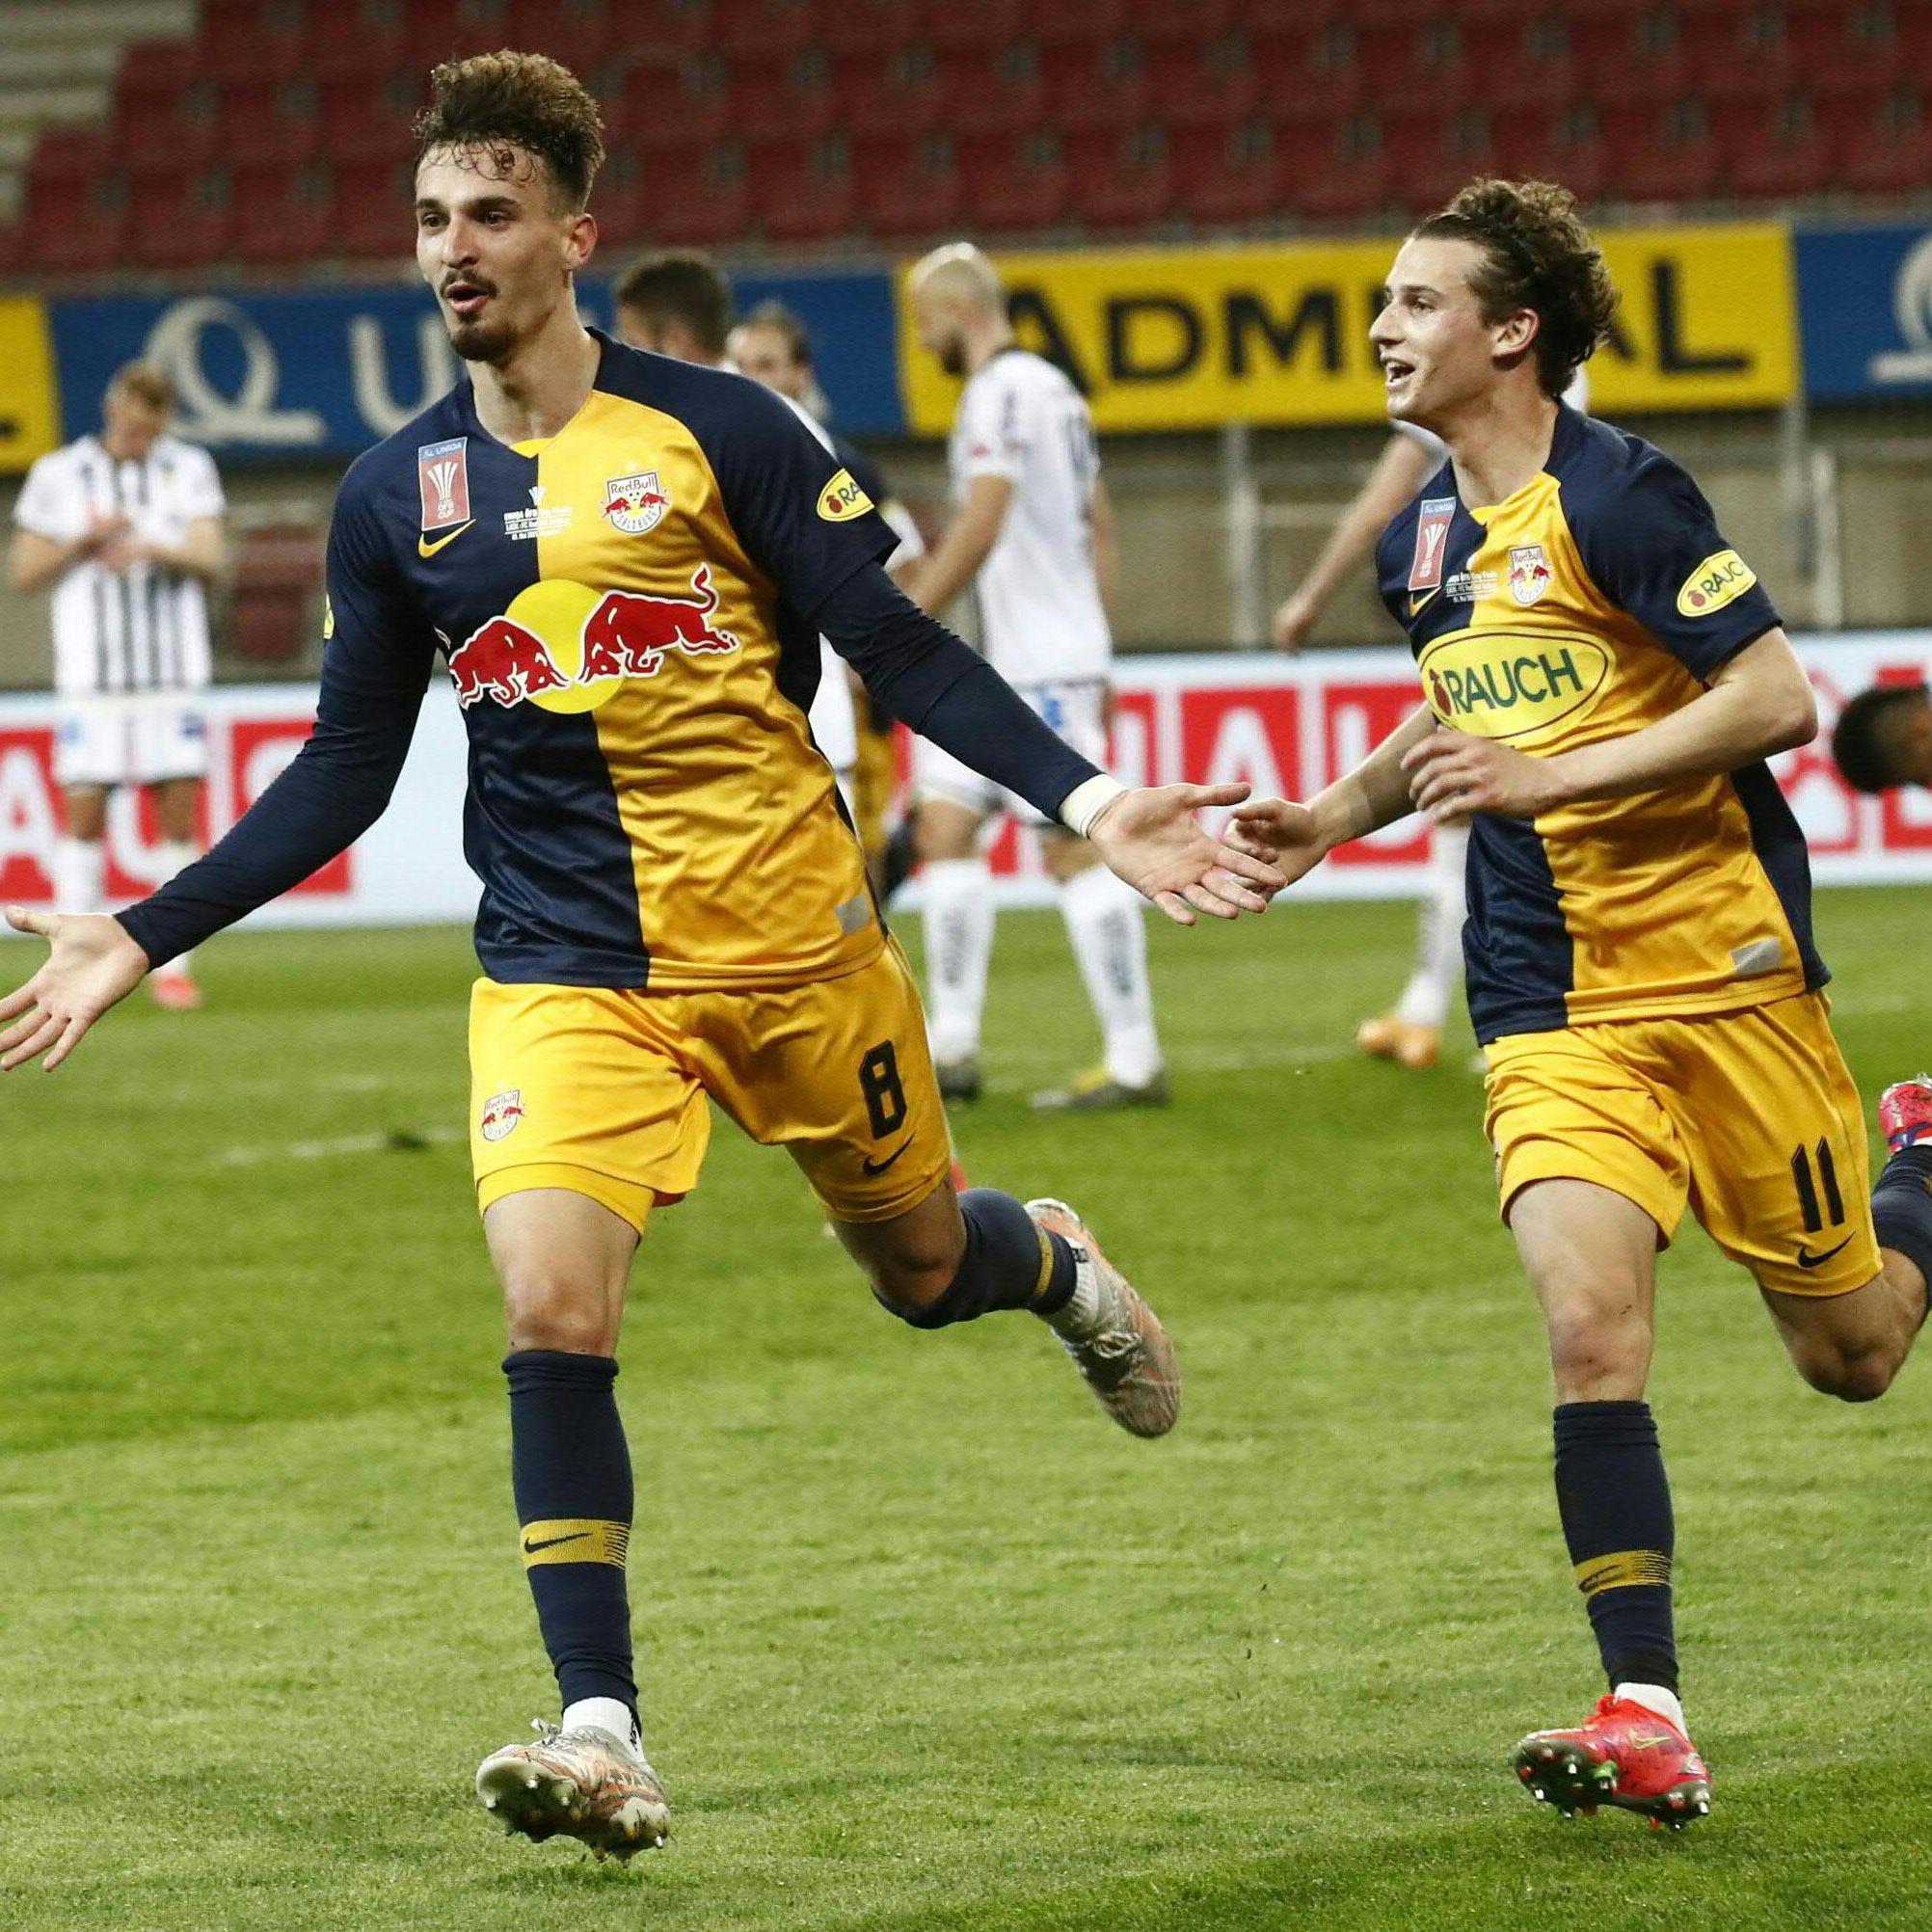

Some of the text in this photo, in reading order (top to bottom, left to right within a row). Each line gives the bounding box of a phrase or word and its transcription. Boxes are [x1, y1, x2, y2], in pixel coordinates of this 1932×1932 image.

[1443, 648, 1583, 714] RAUCH
[858, 1039, 908, 1140] 8
[1790, 1136, 1845, 1233] 11
